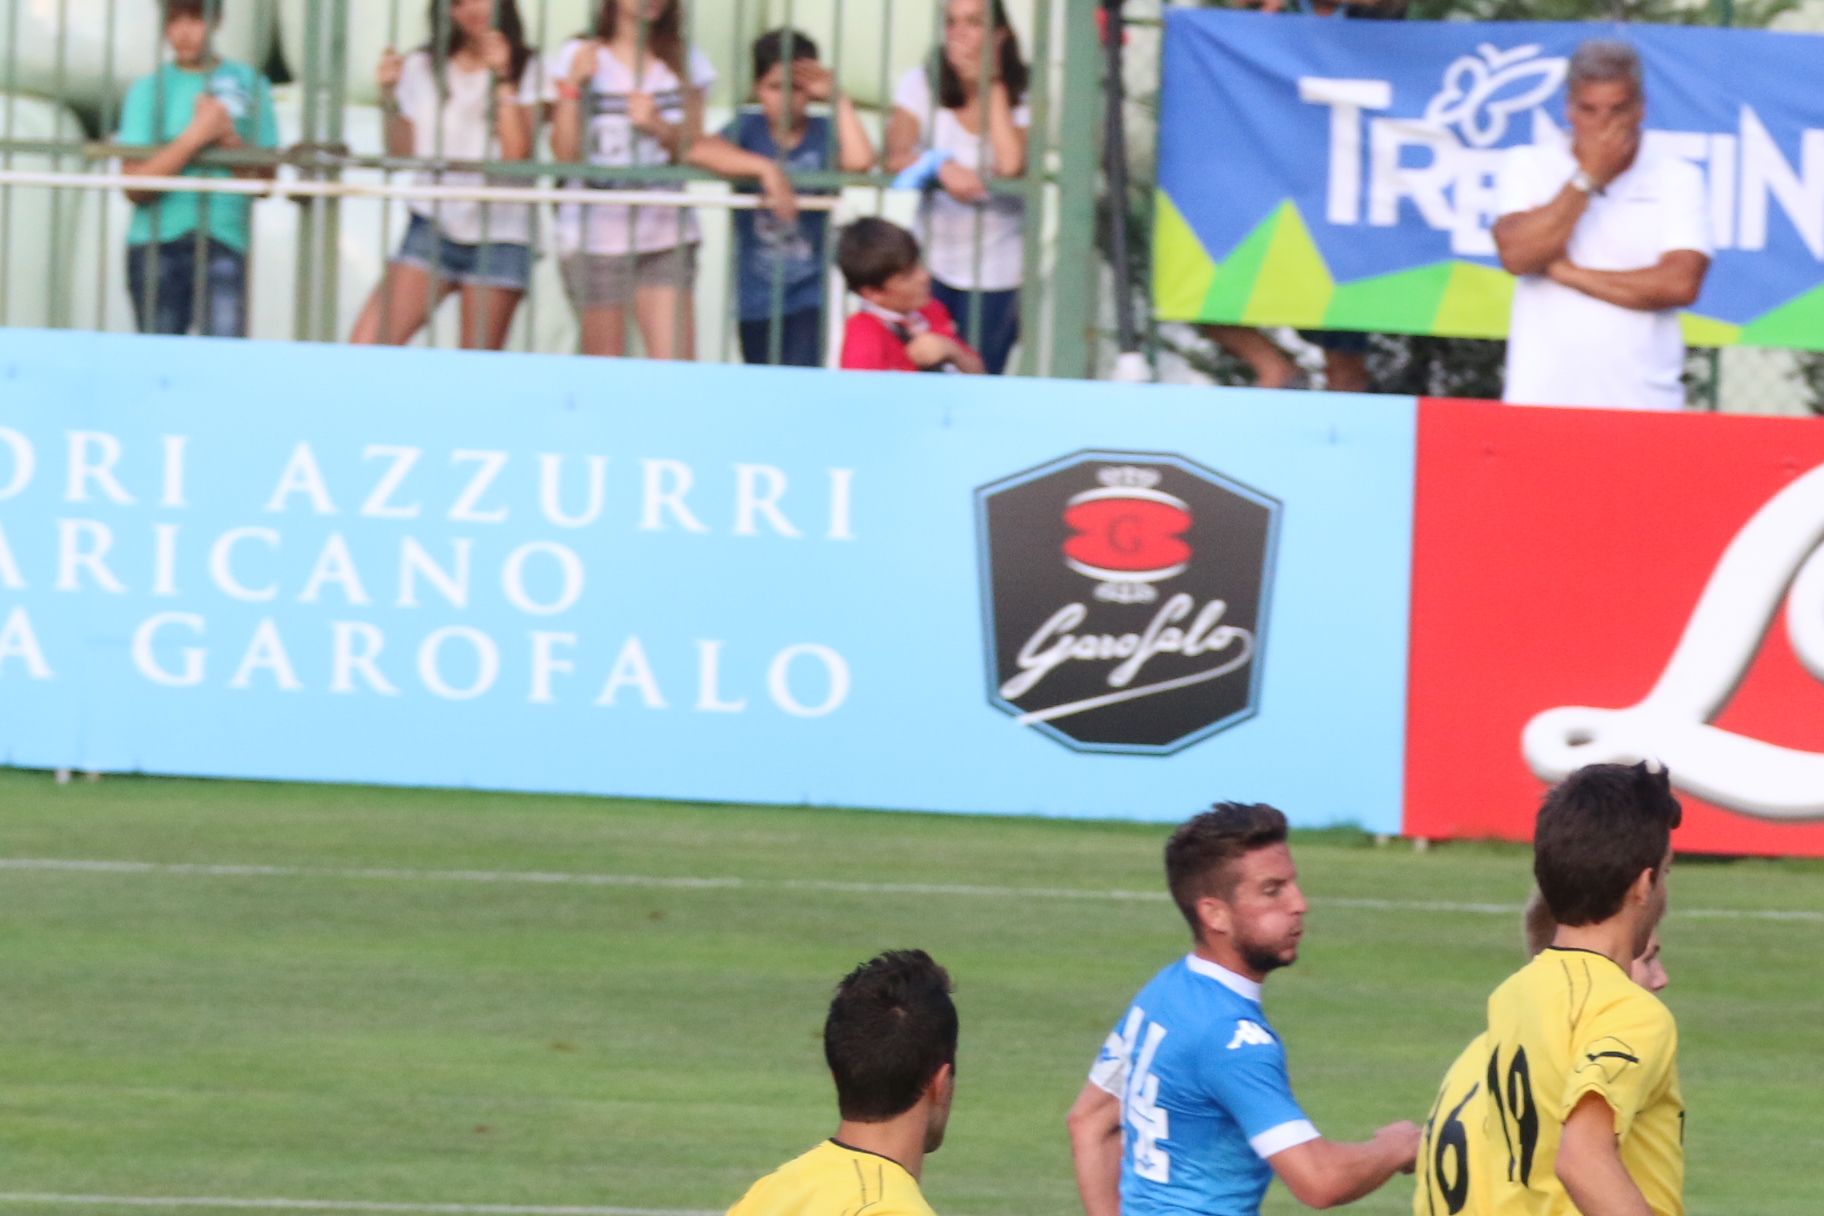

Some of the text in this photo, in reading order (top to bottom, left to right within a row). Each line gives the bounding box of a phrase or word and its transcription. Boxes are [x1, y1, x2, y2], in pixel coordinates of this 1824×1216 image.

[264, 441, 857, 541] AZZURRI
[131, 610, 851, 719] GAROFALO
[1000, 593, 1253, 725] Garofalo
[1487, 1042, 1539, 1188] 19
